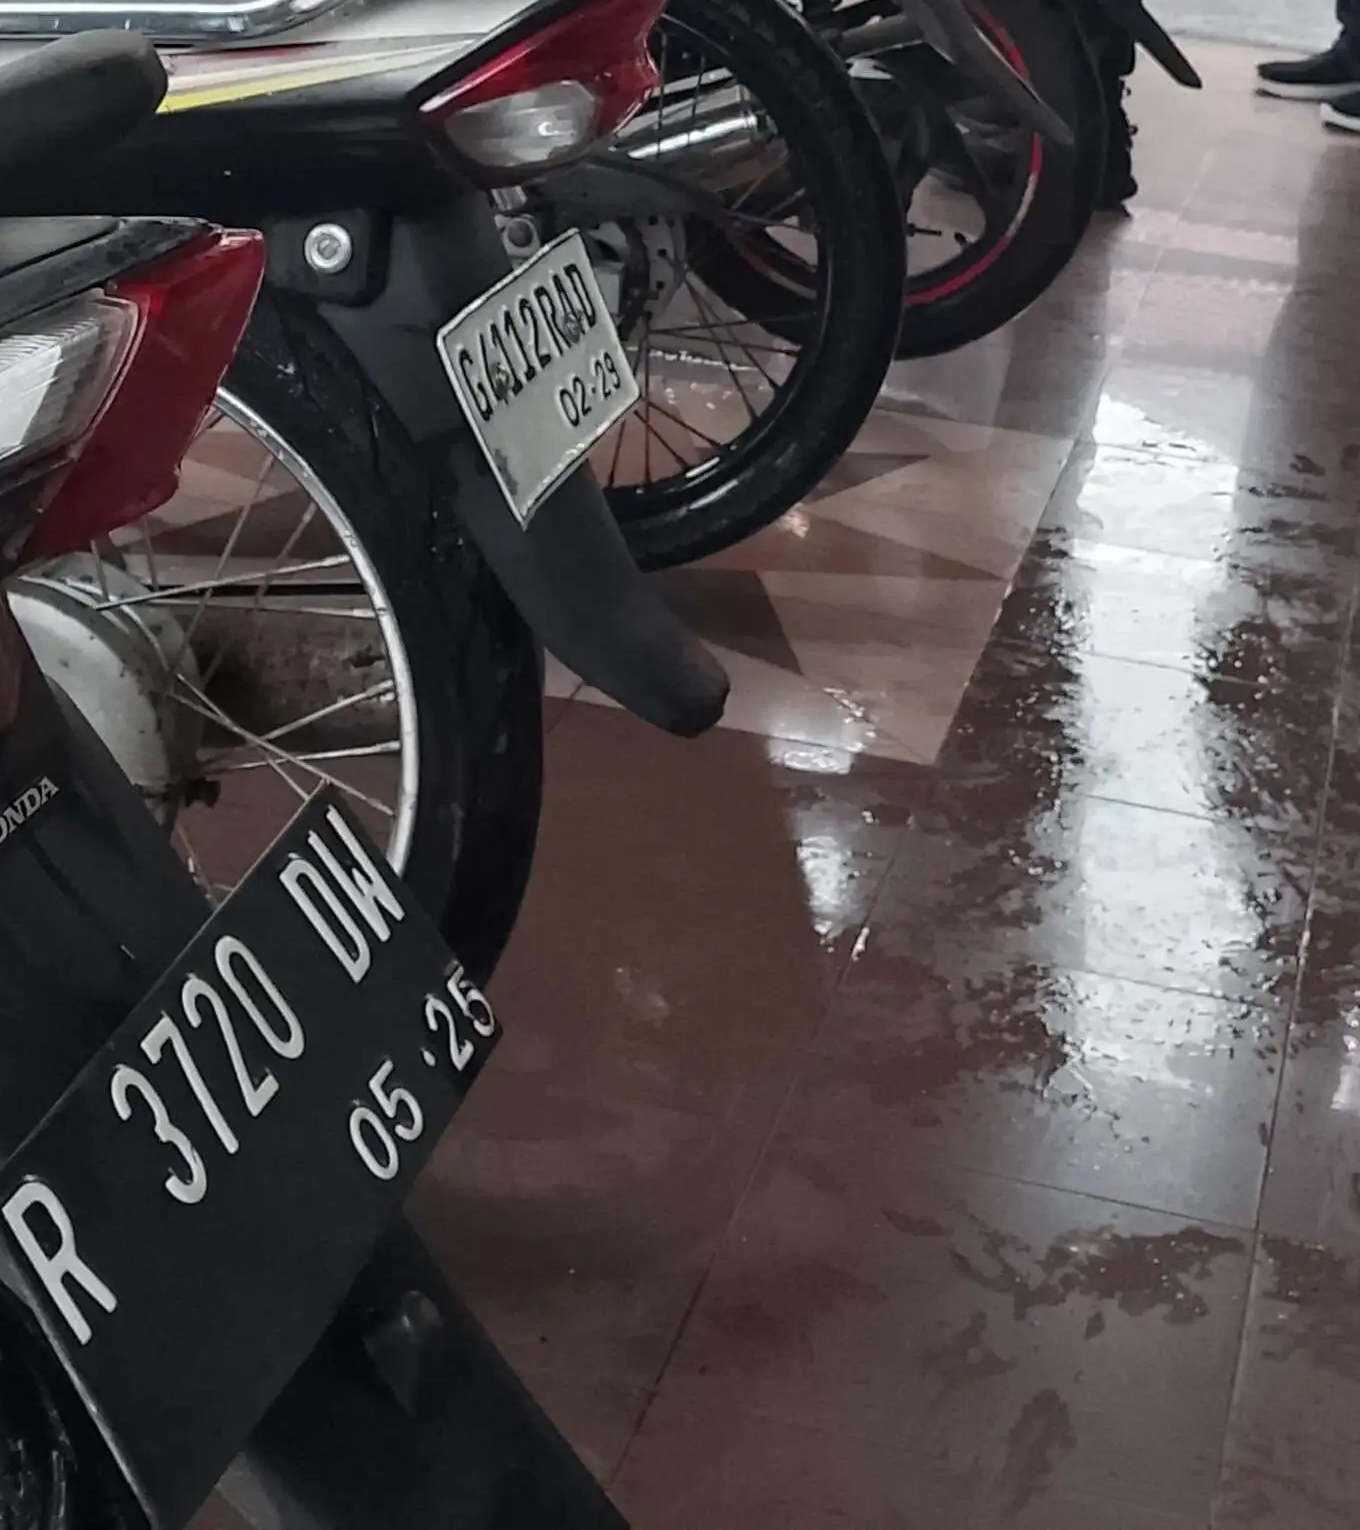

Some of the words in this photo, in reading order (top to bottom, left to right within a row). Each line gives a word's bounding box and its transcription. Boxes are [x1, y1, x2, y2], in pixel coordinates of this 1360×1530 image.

[1, 1177, 117, 1346] R
[111, 934, 305, 1205] 3720
[278, 804, 406, 984] DW
